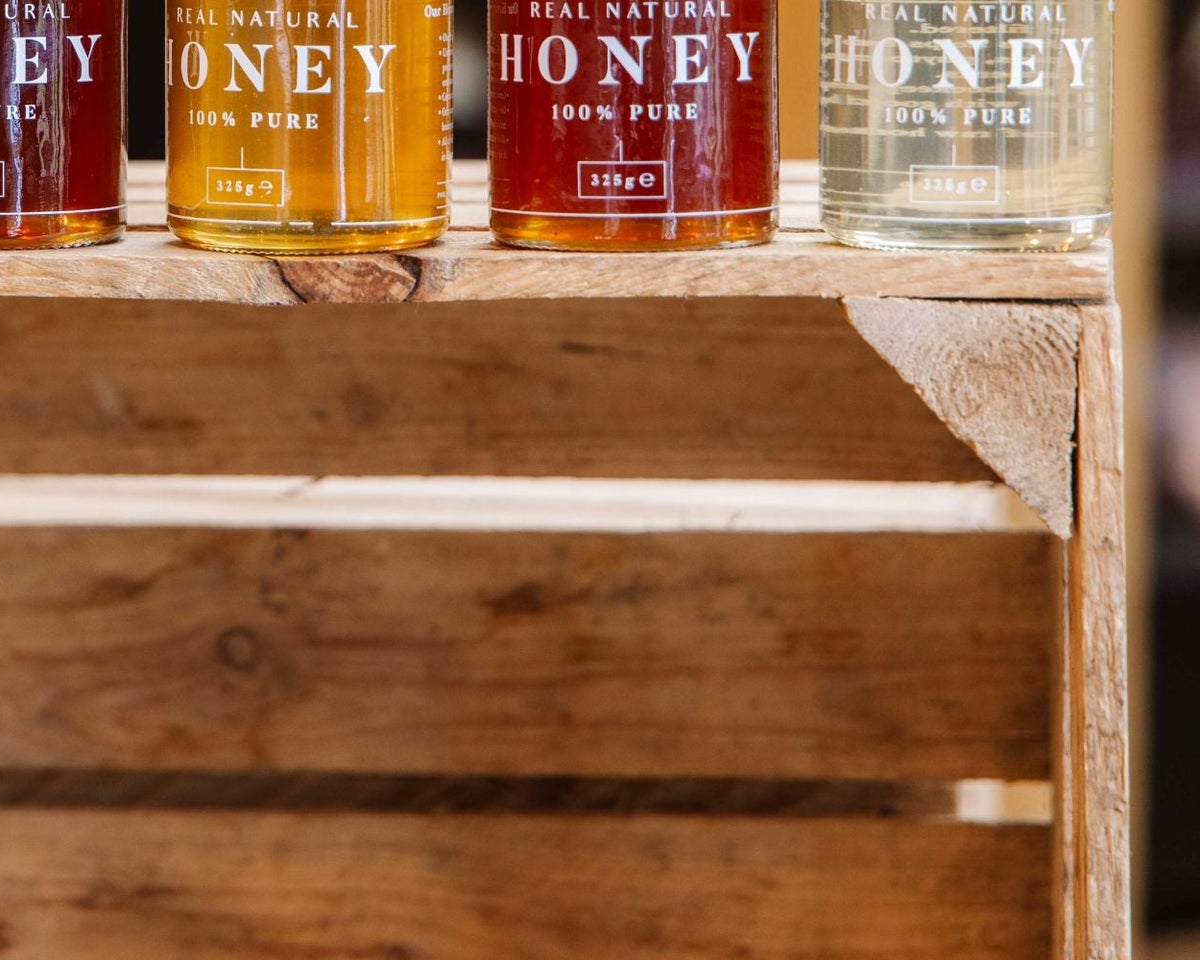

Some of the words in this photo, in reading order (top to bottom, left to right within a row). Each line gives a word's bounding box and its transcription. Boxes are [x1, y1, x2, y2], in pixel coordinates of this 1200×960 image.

[176, 7, 218, 26] REAL
[231, 9, 359, 29] NATURAL
[424, 4, 441, 18] Our
[530, 1, 590, 20] REAL
[606, 0, 731, 20] NATURAL
[865, 3, 926, 22] REAL
[942, 4, 1067, 24] NATURAL
[500, 31, 760, 85] HONEY
[833, 34, 1094, 89] HONEY
[188, 109, 236, 127] 100%
[250, 112, 319, 130] PURE
[551, 103, 613, 121] 100%
[629, 103, 698, 121] PURE
[884, 106, 948, 125] 100%
[964, 107, 1032, 125] PURE
